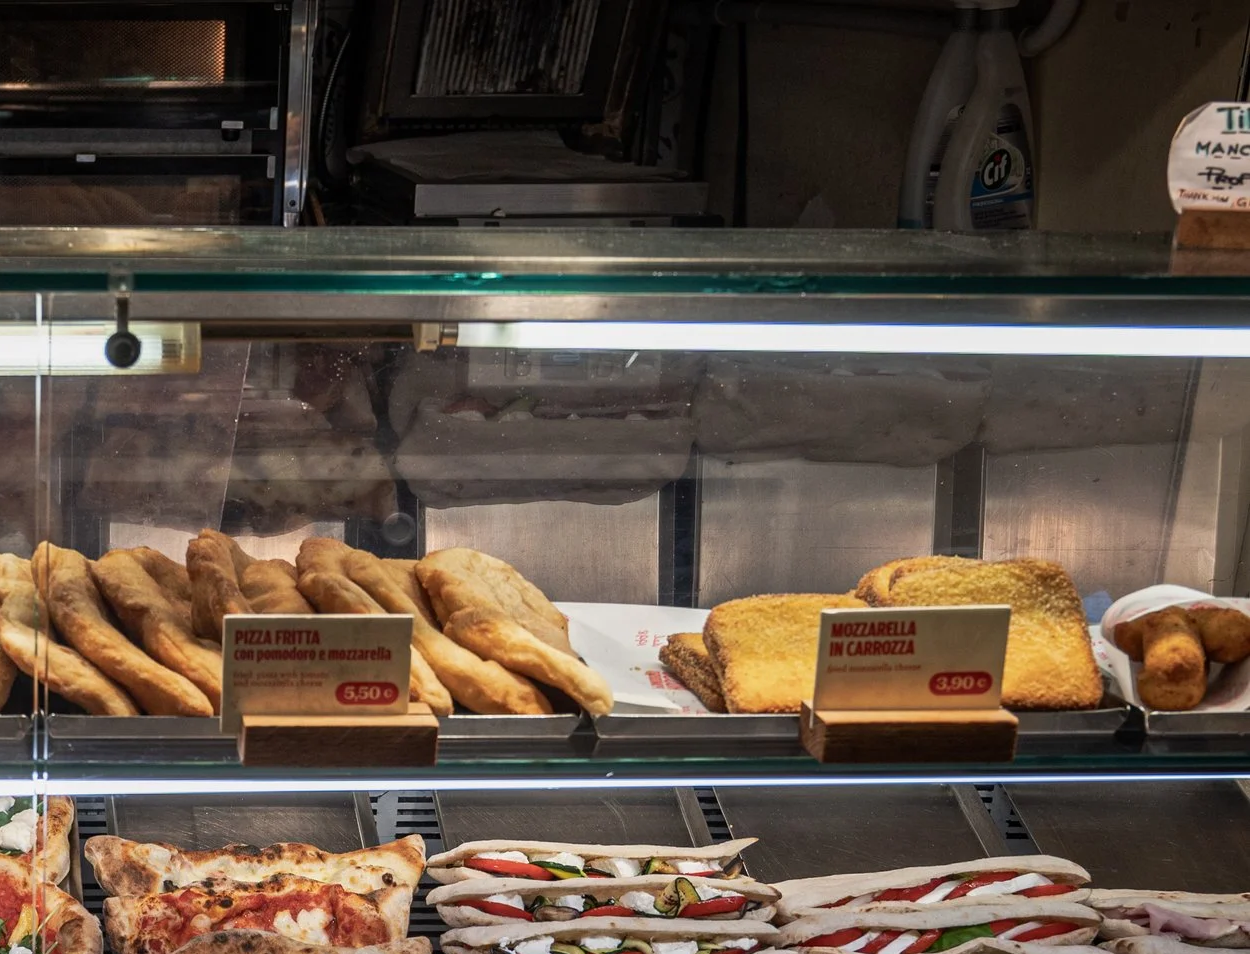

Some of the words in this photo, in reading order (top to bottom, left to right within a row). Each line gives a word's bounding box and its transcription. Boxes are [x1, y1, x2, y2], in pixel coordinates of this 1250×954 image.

[1217, 107, 1250, 130] Ti
[984, 153, 1008, 186] Cif
[831, 621, 916, 637] MOZZARELLA
[235, 630, 271, 644] PIZZA
[276, 630, 320, 645] FRITTA
[234, 650, 254, 660] con
[257, 648, 315, 663] pomodoro
[319, 651, 325, 660] e
[329, 648, 392, 661] mozzarella
[830, 642, 843, 657] IN
[847, 640, 915, 656] CARROZZA
